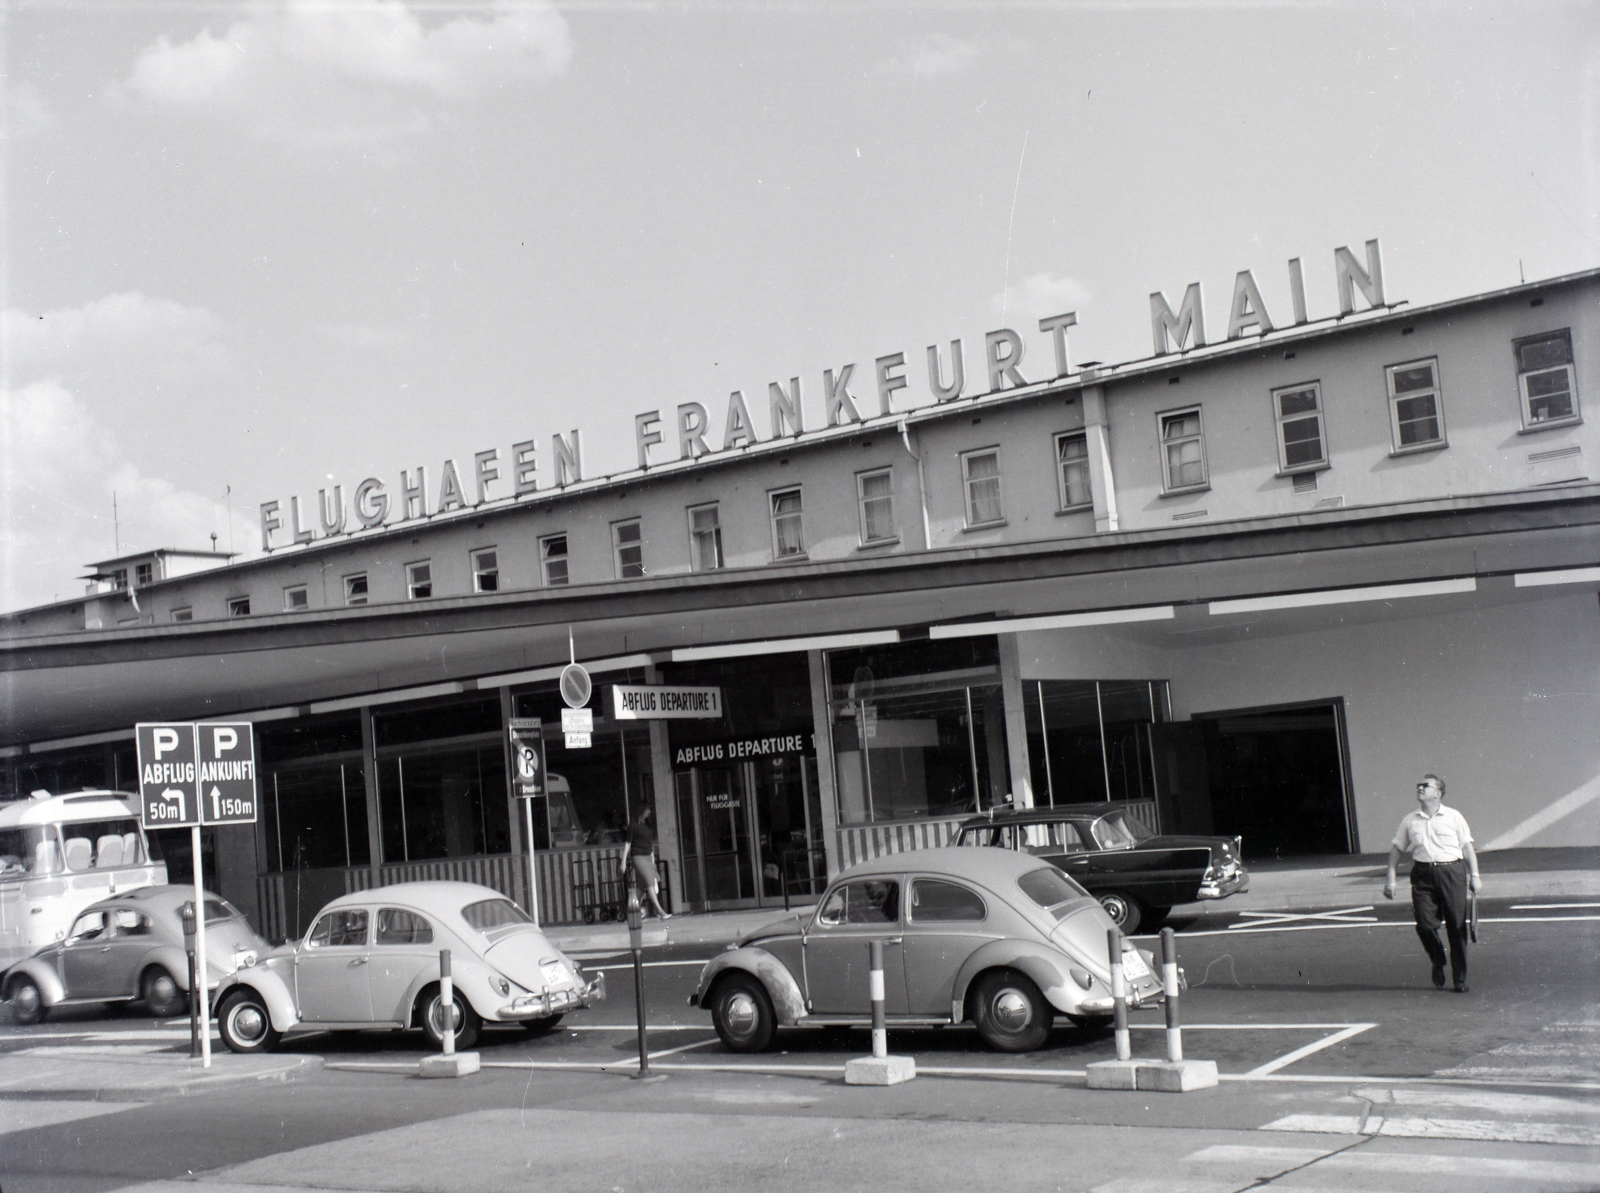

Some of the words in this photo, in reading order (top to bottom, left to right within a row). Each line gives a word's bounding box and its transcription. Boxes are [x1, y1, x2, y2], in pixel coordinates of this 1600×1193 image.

[260, 429, 583, 551] FLUGHAFEN
[634, 311, 1079, 468] FRANKFURT
[1149, 238, 1387, 356] MAIN
[622, 693, 656, 711] ABFLUG
[660, 692, 710, 711] DEPARTURE
[711, 692, 717, 711] 1
[153, 728, 179, 760] P
[213, 727, 238, 759] P
[570, 736, 588, 746] Anfang
[676, 744, 724, 764] ABFLUG
[729, 735, 803, 759] DEPARTURE
[811, 733, 816, 748] 1
[143, 762, 195, 785] ABFLUG
[201, 760, 253, 782] ANKUNFT
[150, 802, 179, 820] 50m
[221, 798, 252, 815] 150m
